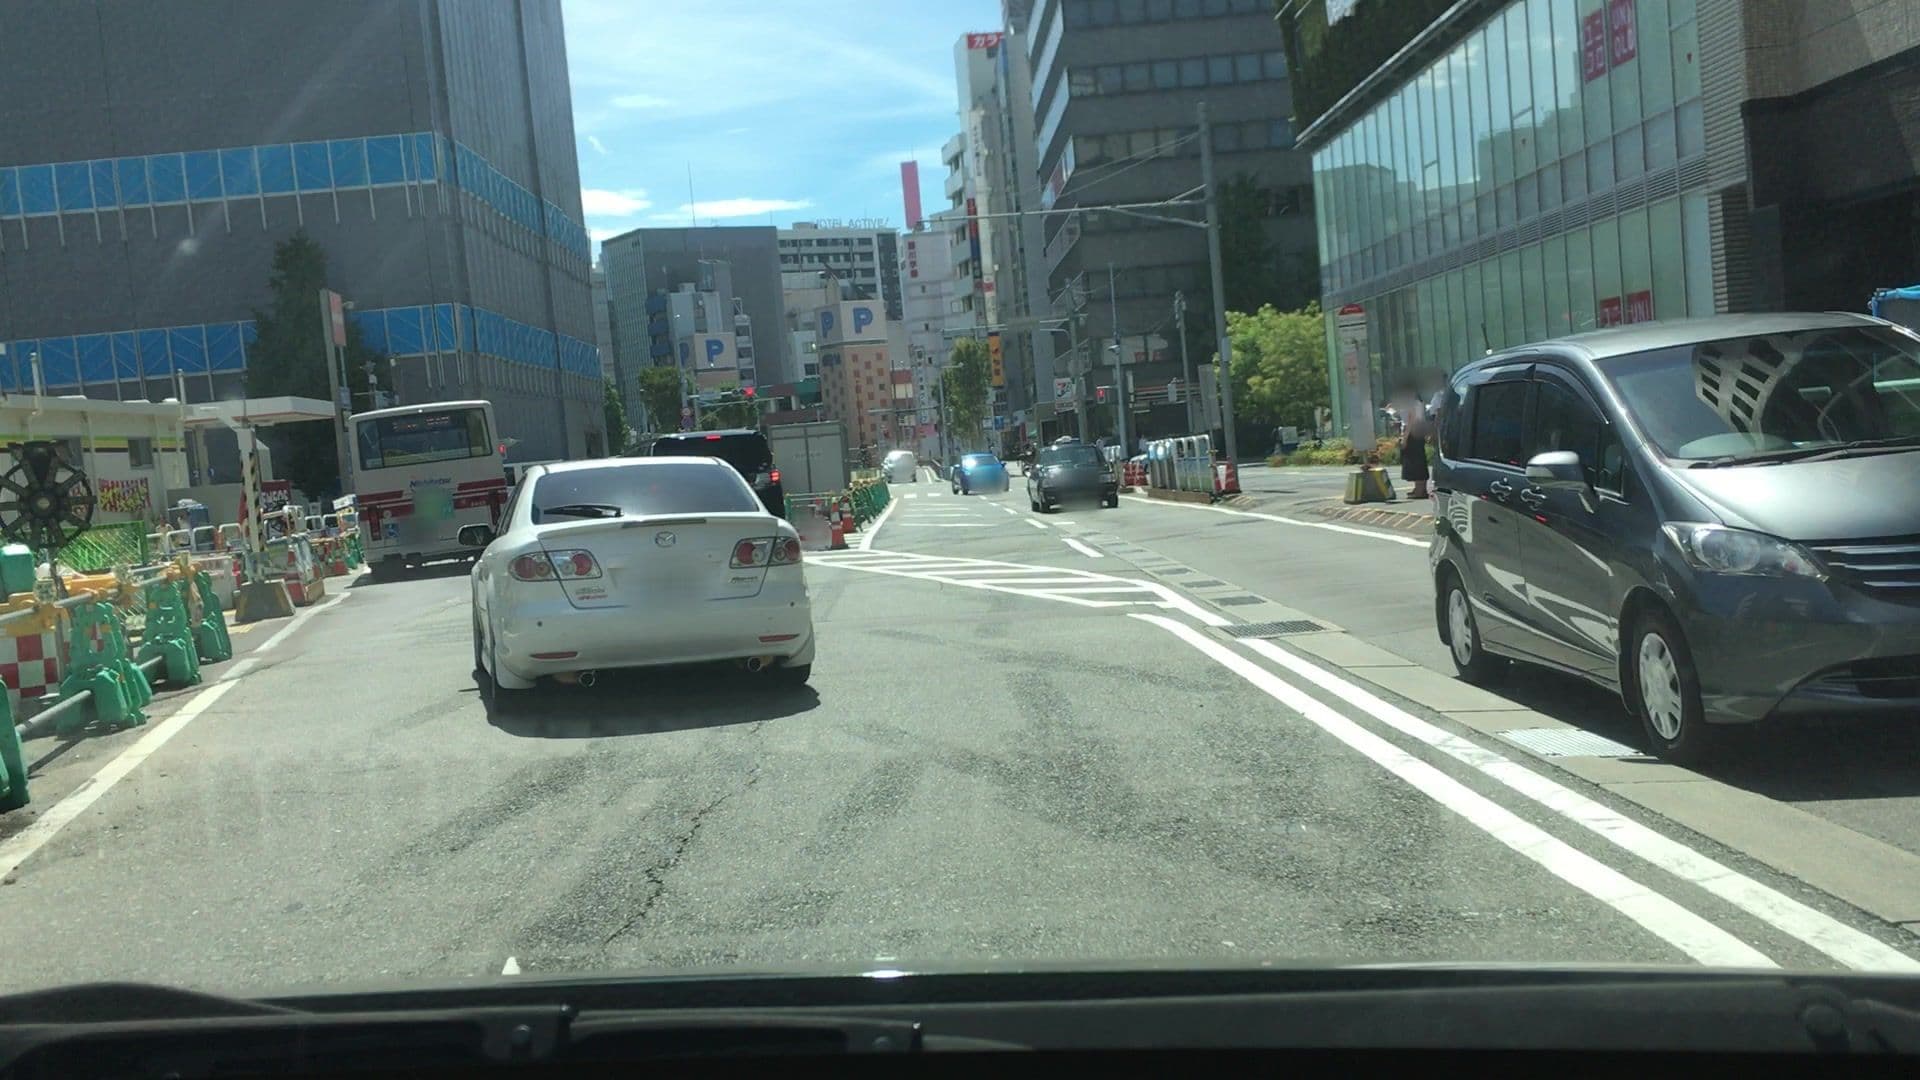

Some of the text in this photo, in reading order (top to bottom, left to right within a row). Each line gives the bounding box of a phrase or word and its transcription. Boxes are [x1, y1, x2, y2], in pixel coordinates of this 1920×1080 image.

[821, 311, 834, 338] P
[853, 307, 873, 334] P
[706, 339, 724, 363] P
